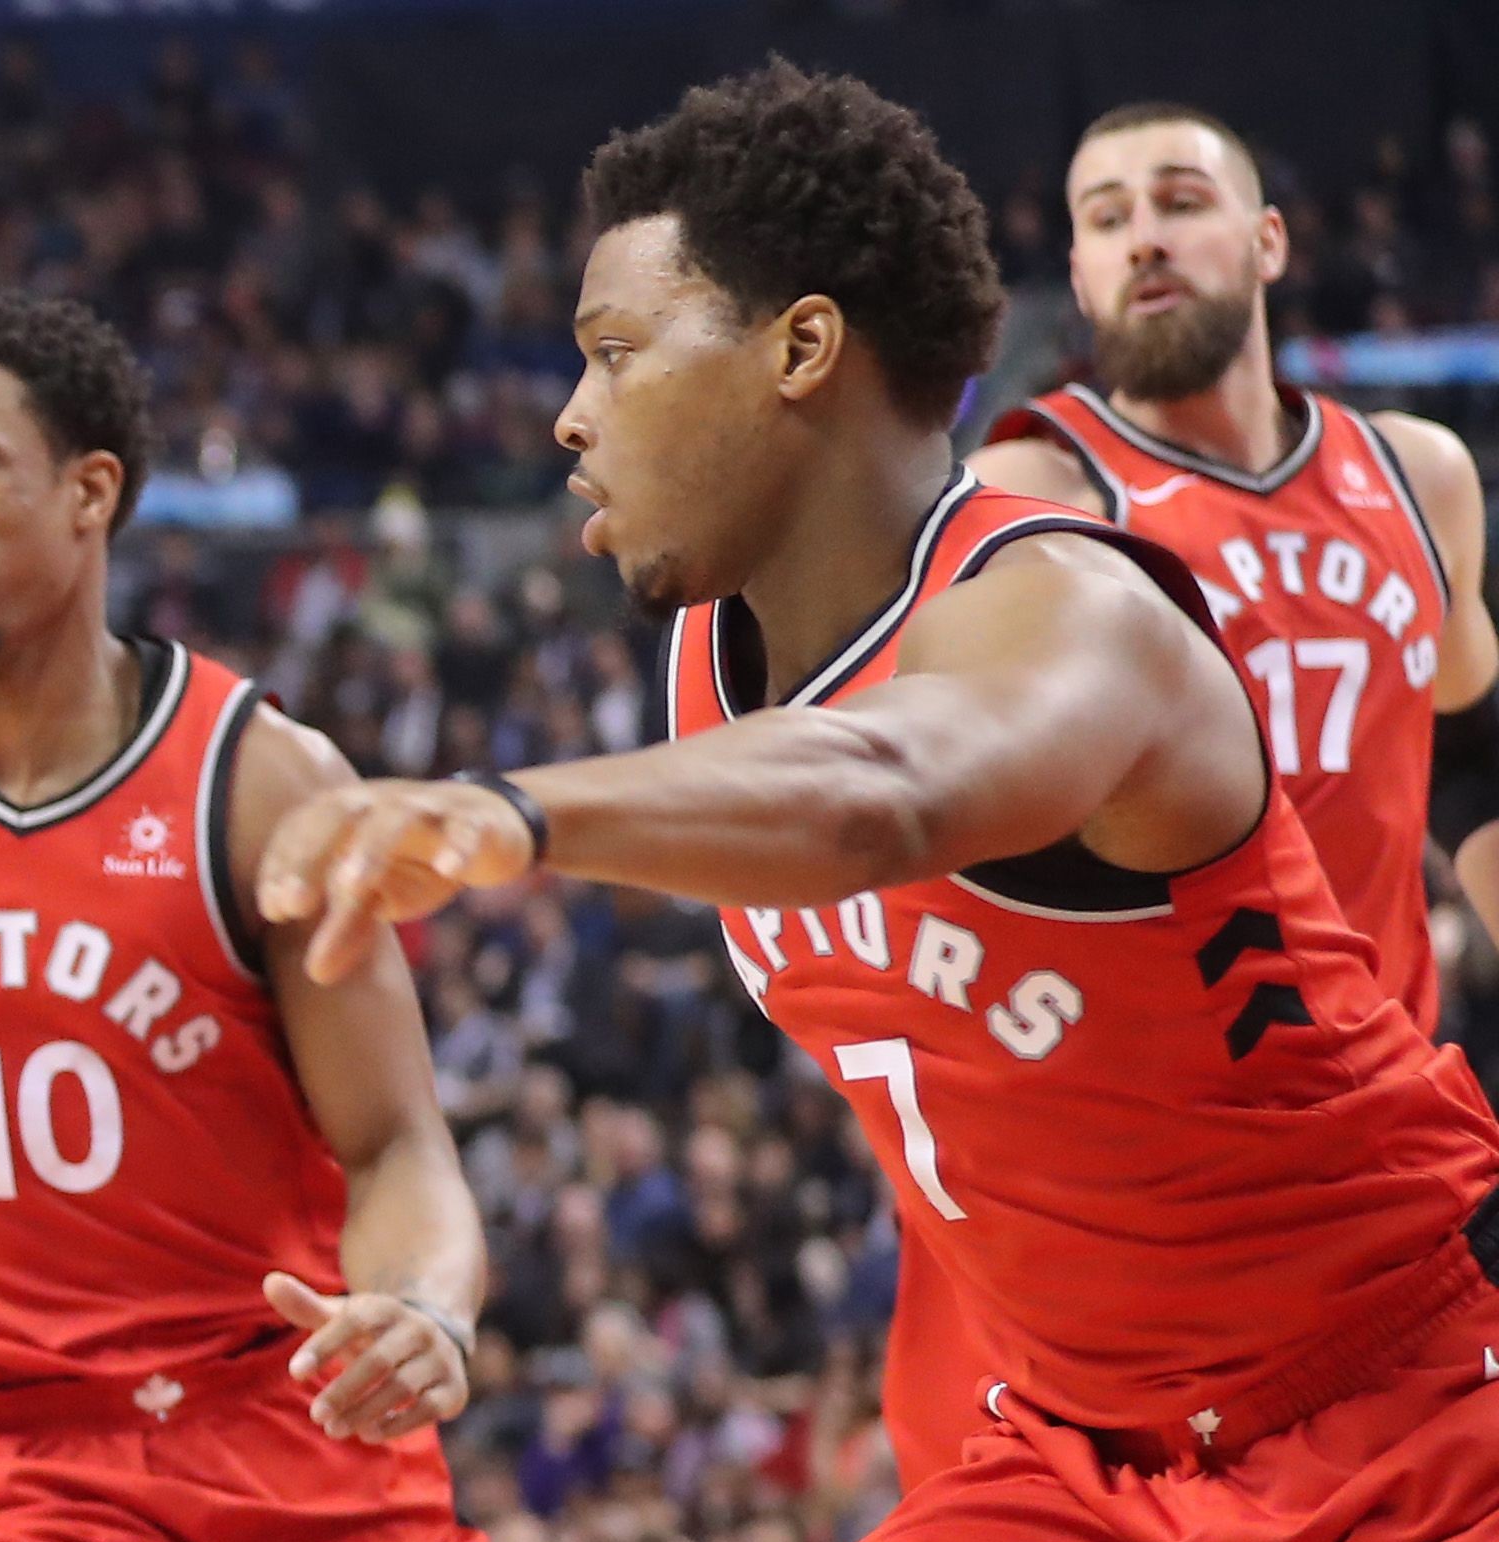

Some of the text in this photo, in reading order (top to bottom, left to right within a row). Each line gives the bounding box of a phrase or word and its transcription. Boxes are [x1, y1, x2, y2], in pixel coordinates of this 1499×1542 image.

[1194, 532, 1439, 690] APTORS
[1245, 638, 1371, 776] 17
[720, 889, 1085, 1061] APORS
[832, 1036, 969, 1221] 7
